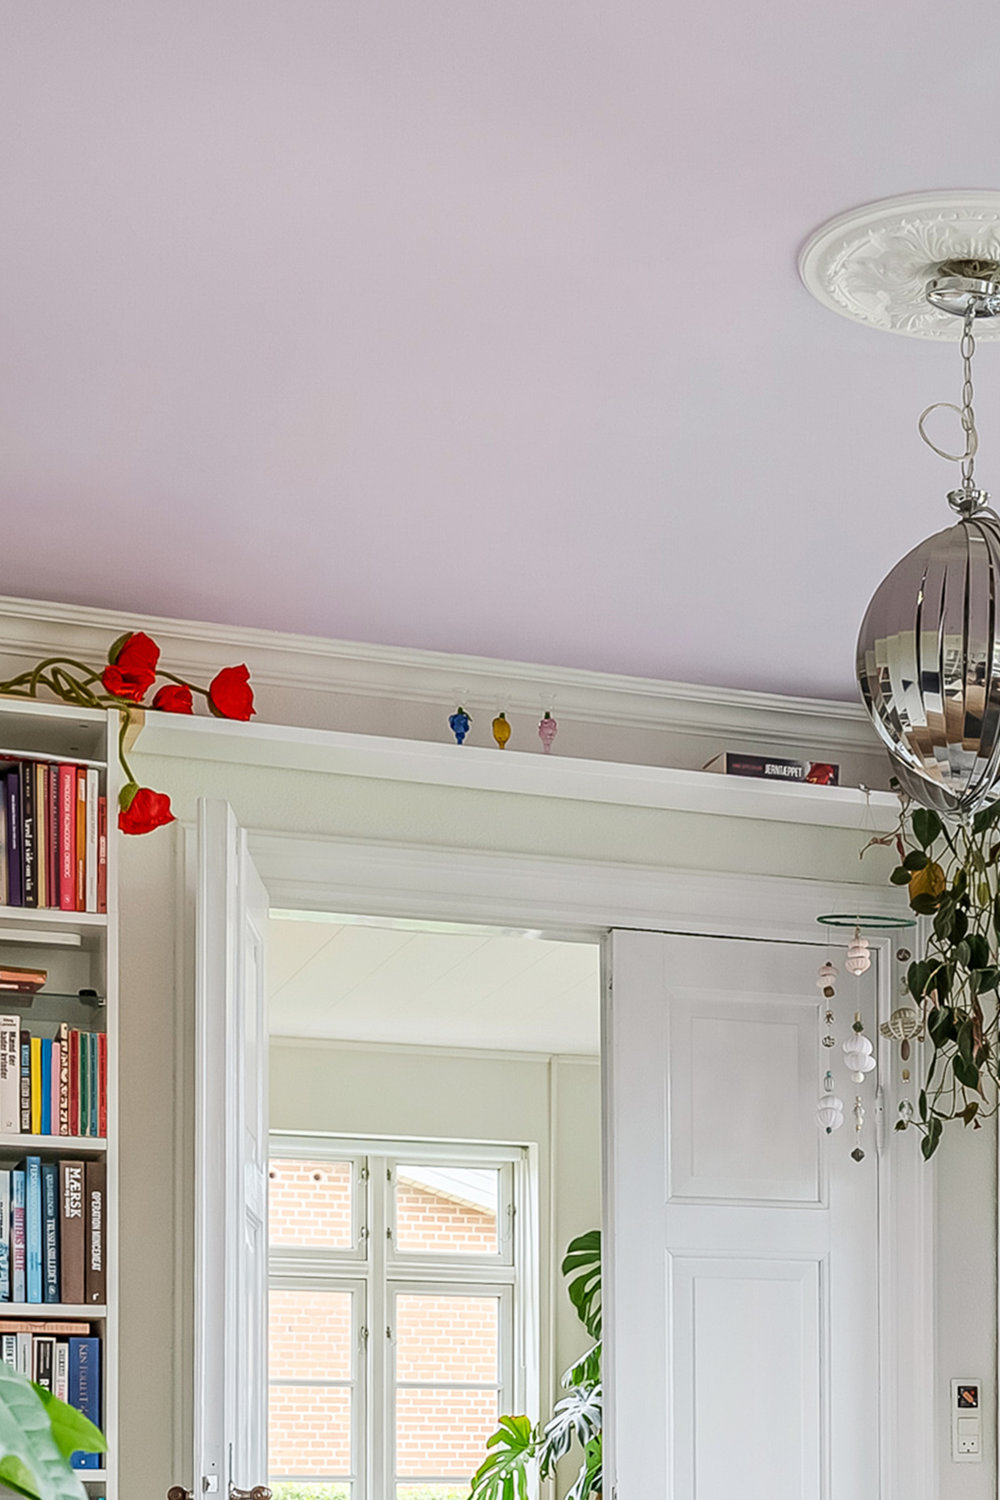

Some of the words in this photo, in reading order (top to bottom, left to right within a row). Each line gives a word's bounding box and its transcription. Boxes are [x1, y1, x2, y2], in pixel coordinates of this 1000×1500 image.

[9, 1055, 17, 1066] der
[69, 1167, 81, 1218] MÆRSK
[91, 1191, 102, 1230] OPERATION
[91, 1231, 102, 1272] MINCEMEAT
[79, 1344, 88, 1364] KEN
[79, 1366, 88, 1402] FOLLETT
